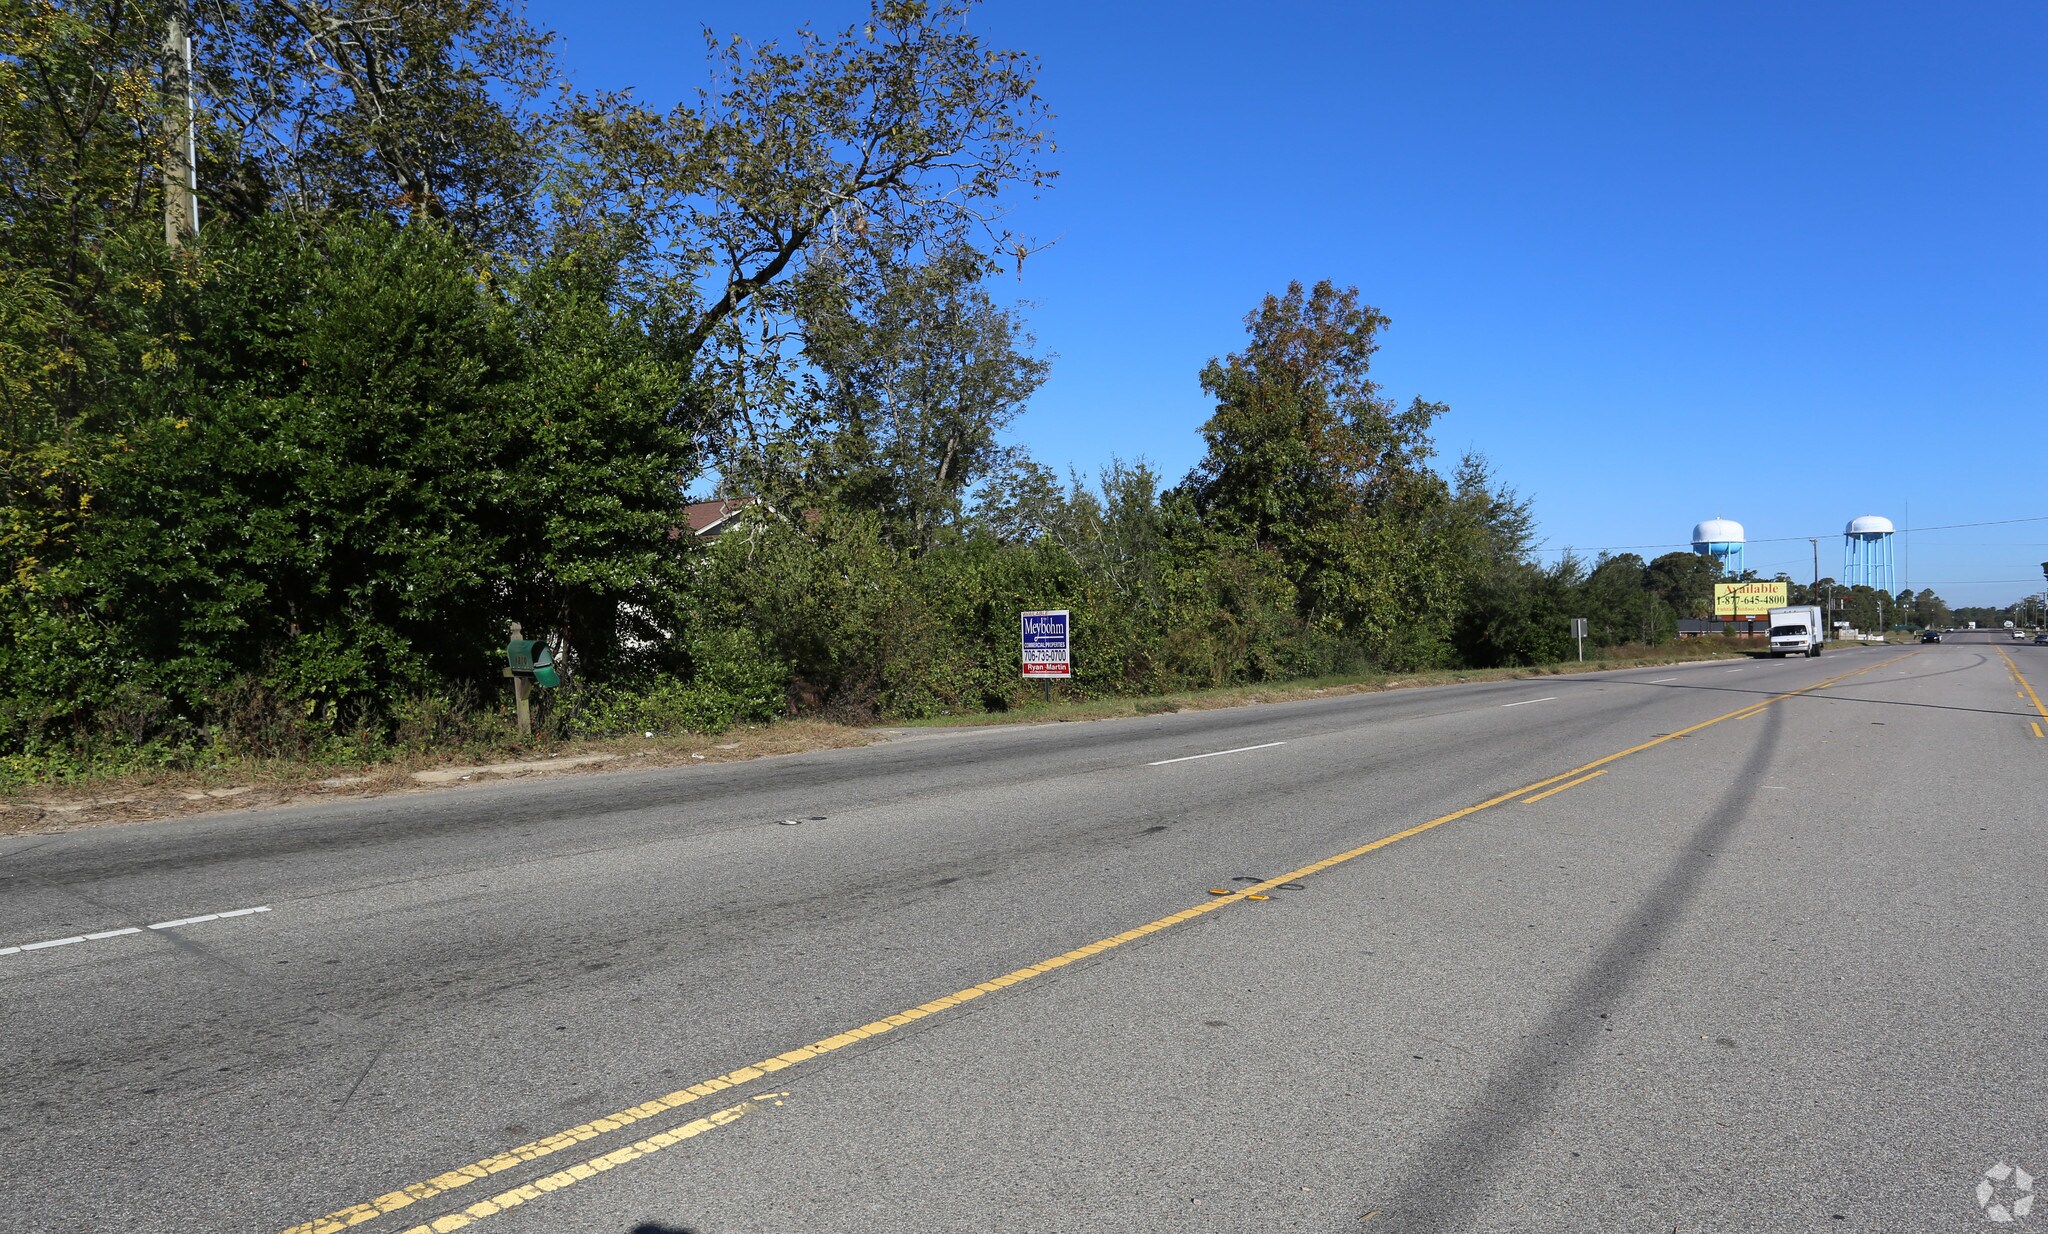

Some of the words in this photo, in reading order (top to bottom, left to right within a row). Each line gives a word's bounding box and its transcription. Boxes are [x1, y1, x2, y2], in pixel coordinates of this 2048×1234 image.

[1725, 584, 1779, 594] Available
[1717, 595, 1785, 605] 1-877-645-4800
[1024, 617, 1064, 637] Meybohm
[1028, 664, 1043, 672] Ryan
[1046, 663, 1066, 671] Martin
